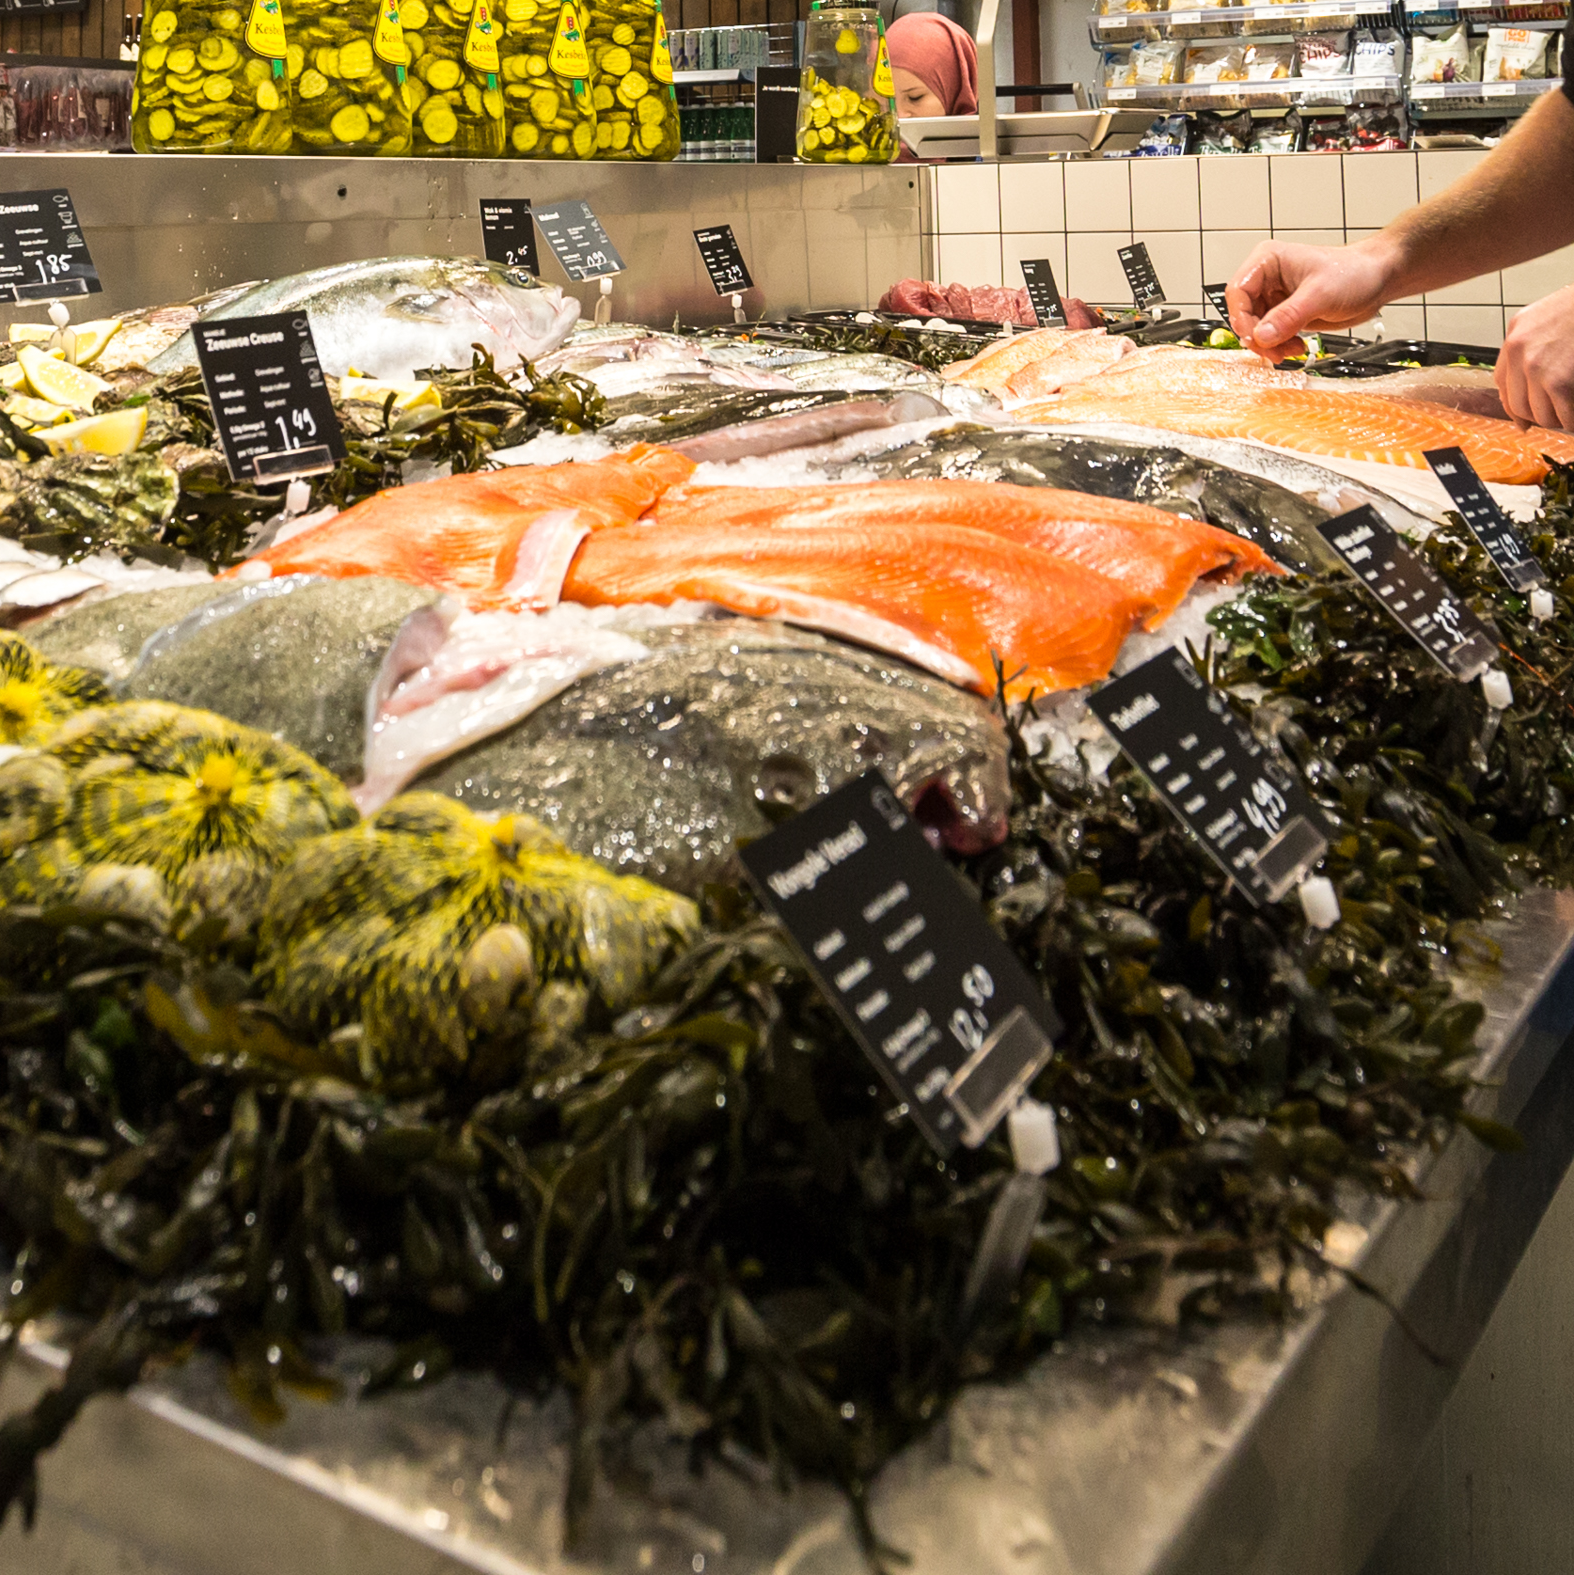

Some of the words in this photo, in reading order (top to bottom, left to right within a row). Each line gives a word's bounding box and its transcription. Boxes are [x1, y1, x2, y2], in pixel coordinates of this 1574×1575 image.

[1355, 41, 1396, 58] CHIPS
[205, 335, 250, 353] Zeeuwse
[250, 330, 285, 347] Creuse
